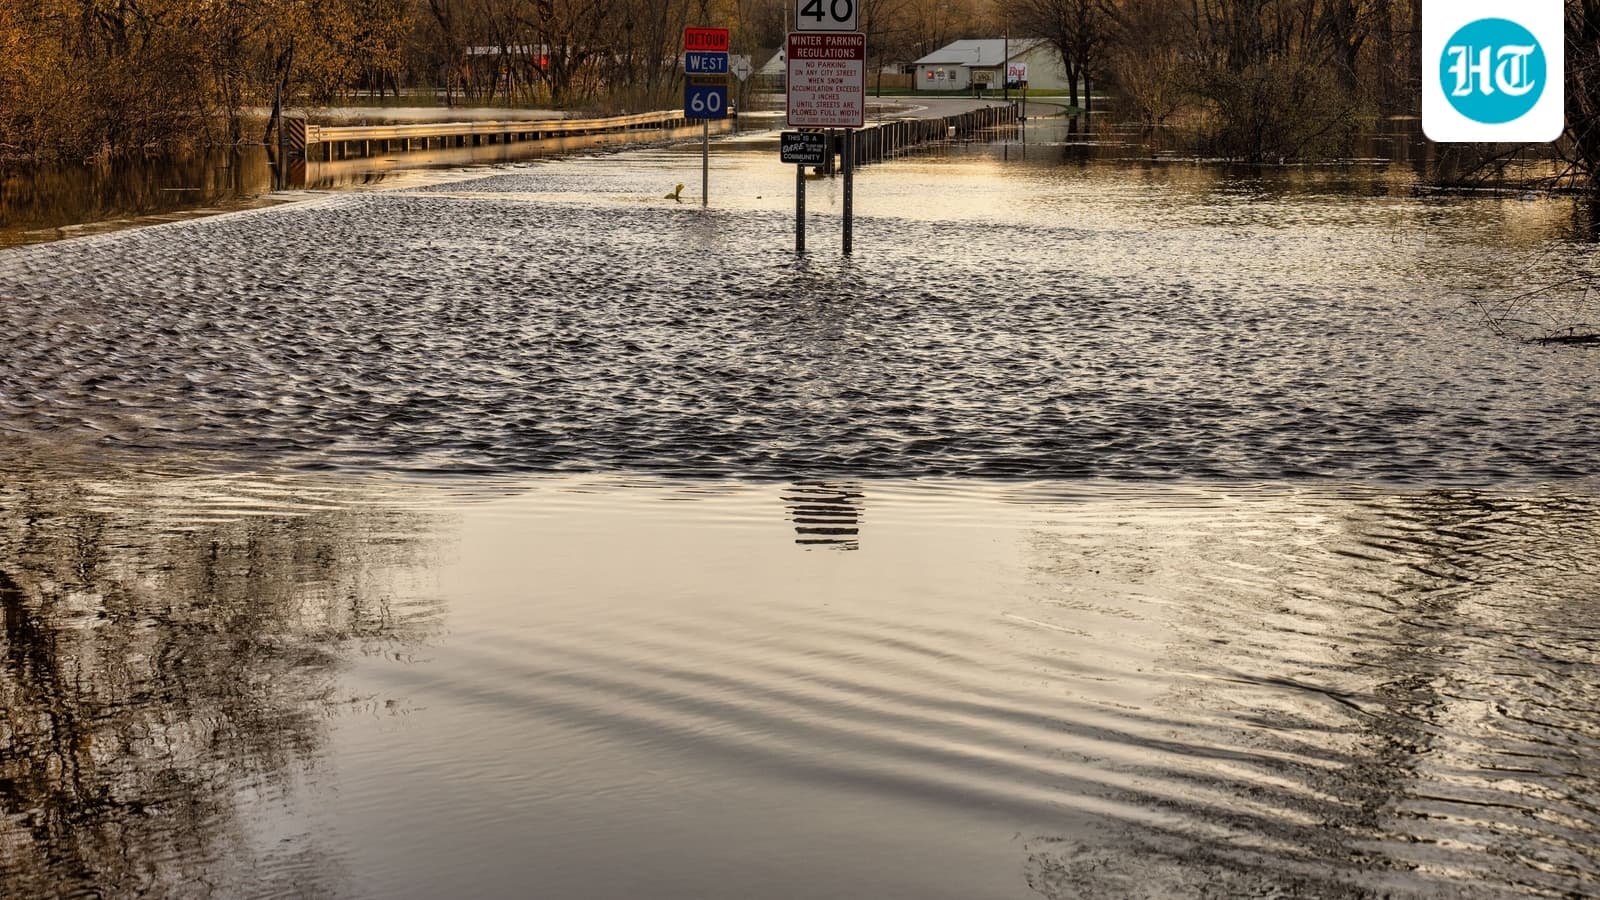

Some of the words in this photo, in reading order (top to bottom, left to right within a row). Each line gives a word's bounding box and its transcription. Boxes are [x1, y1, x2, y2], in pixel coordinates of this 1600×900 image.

[800, 0, 852, 22] 40
[688, 33, 726, 46] DETOUR
[790, 36, 822, 46] WINTER
[826, 36, 863, 46] PARKING
[797, 48, 855, 58] REGULATIONS
[690, 55, 724, 70] WEST
[691, 91, 721, 112] 60
[791, 108, 818, 116] PLOWED
